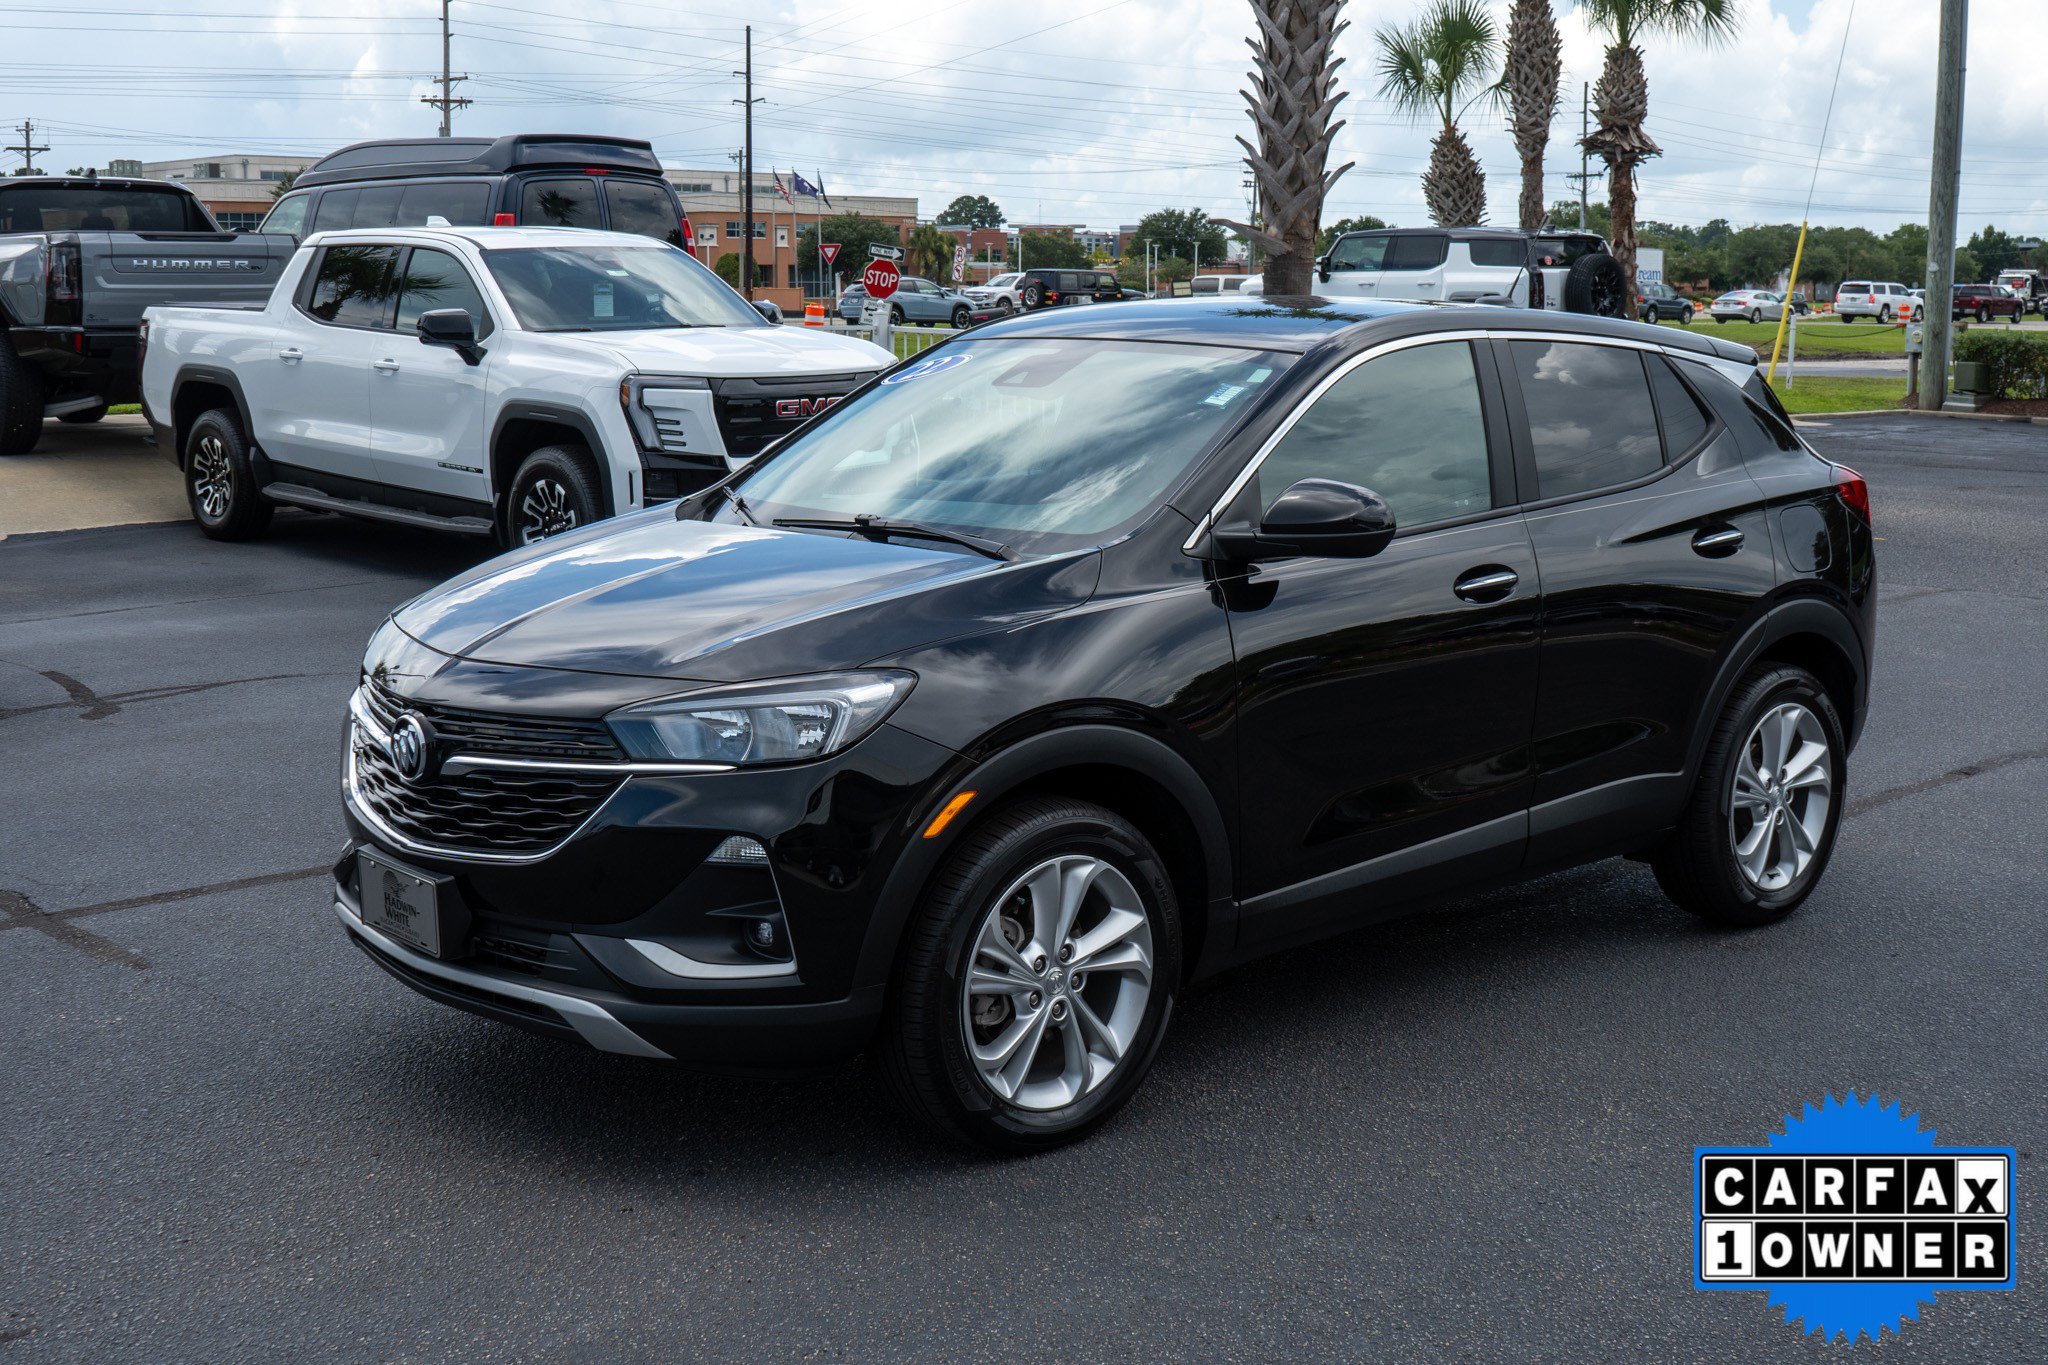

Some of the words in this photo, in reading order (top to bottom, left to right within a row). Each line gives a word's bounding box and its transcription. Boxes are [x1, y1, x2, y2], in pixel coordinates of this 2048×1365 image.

[133, 259, 250, 270] HUMMER
[866, 270, 897, 288] STOP
[384, 892, 420, 917] HADWIN-
[384, 904, 410, 927] WHITE
